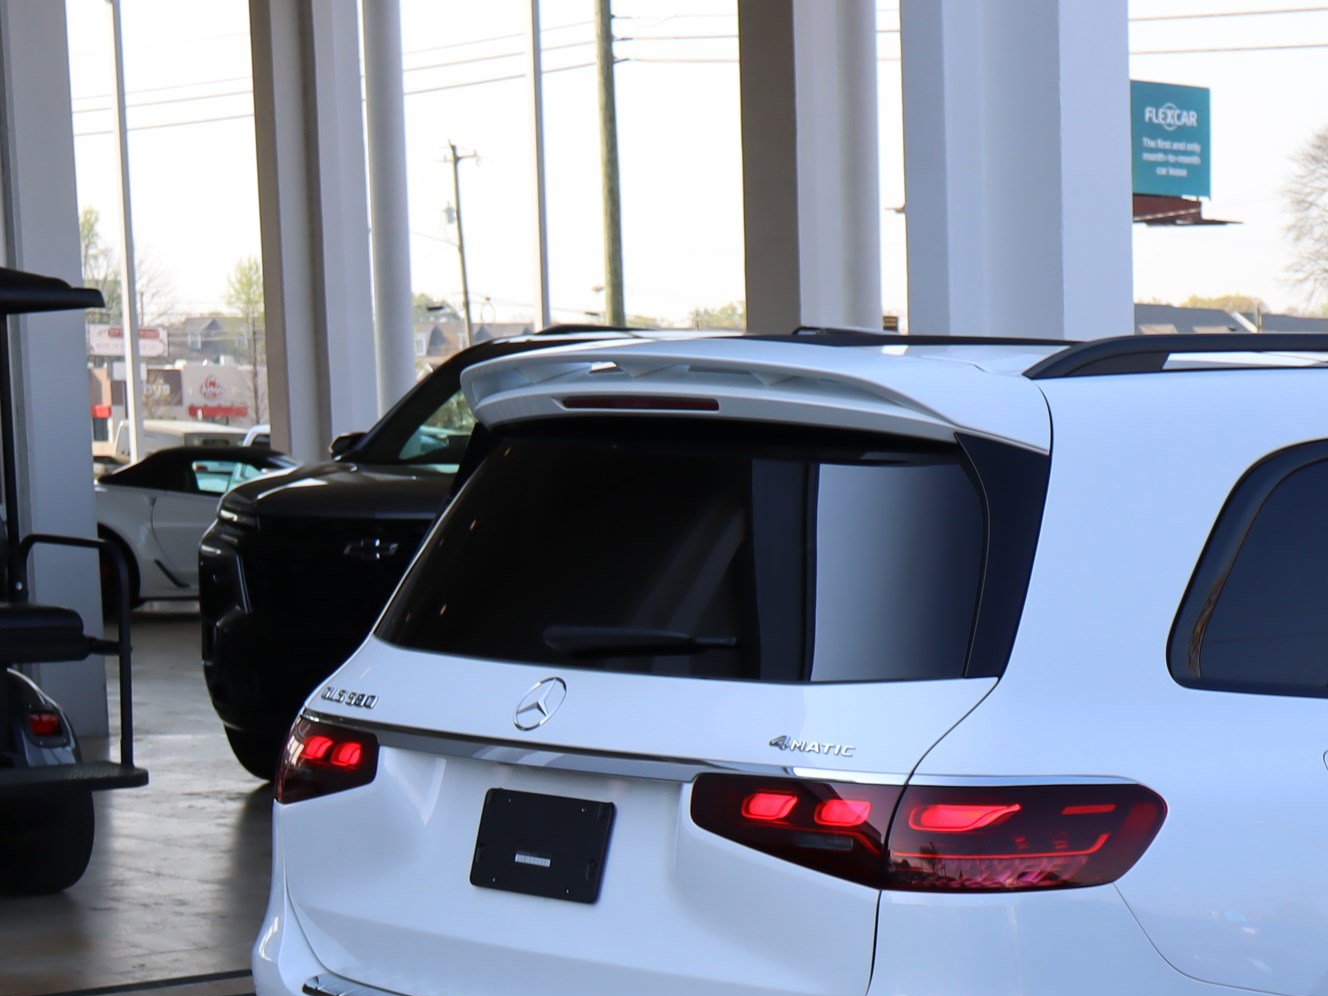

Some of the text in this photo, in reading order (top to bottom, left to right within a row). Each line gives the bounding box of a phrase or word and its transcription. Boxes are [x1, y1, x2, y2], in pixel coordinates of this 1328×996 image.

[1144, 106, 1198, 127] FLEXCAR
[1142, 137, 1157, 149] The
[321, 686, 379, 710] GLS 580
[769, 735, 856, 757] 4MATIC
